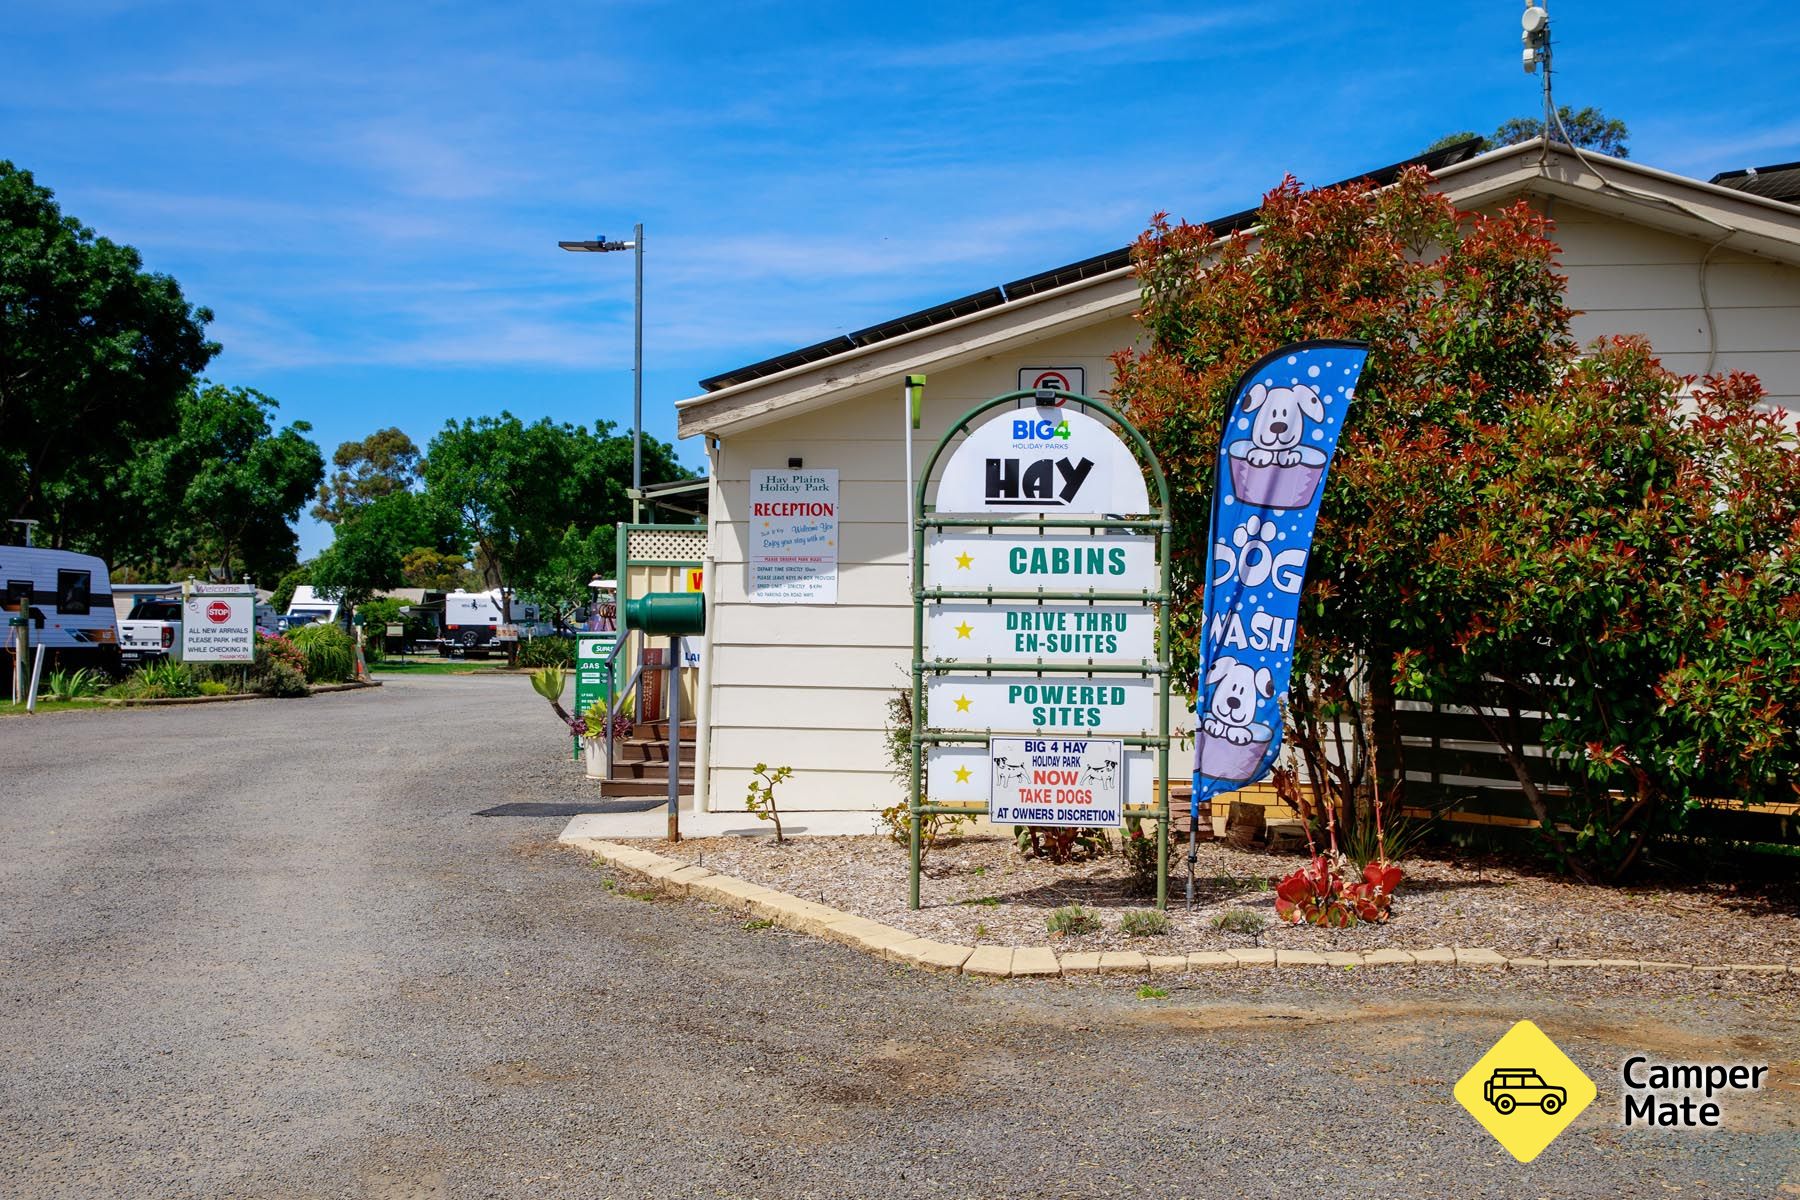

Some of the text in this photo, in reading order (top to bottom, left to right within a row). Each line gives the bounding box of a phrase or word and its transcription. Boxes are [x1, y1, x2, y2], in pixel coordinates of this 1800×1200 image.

[1013, 420, 1071, 440] BIG4
[759, 483, 829, 493] Holiday Park
[766, 475, 825, 485] Hay Plains
[985, 456, 1095, 503] HAY
[754, 502, 834, 517] RECEPTION
[1009, 547, 1126, 575] CABINS
[1213, 539, 1307, 594] DOG
[196, 584, 240, 593] Welcome
[209, 608, 228, 616] STOP
[1006, 611, 1127, 632] DRIVE THRU
[1204, 610, 1294, 652] WASH
[1015, 634, 1118, 653] EN-SUITES
[1009, 685, 1126, 705] POWERED
[1032, 707, 1101, 727] SITES
[1025, 741, 1088, 753] BIG 4 HAY
[1032, 756, 1081, 767] HOLIDAY PARK
[1033, 770, 1079, 785] NOW
[1019, 788, 1093, 805] TAKE DOGS
[997, 808, 1115, 822] AT OWNERS DISCRETION
